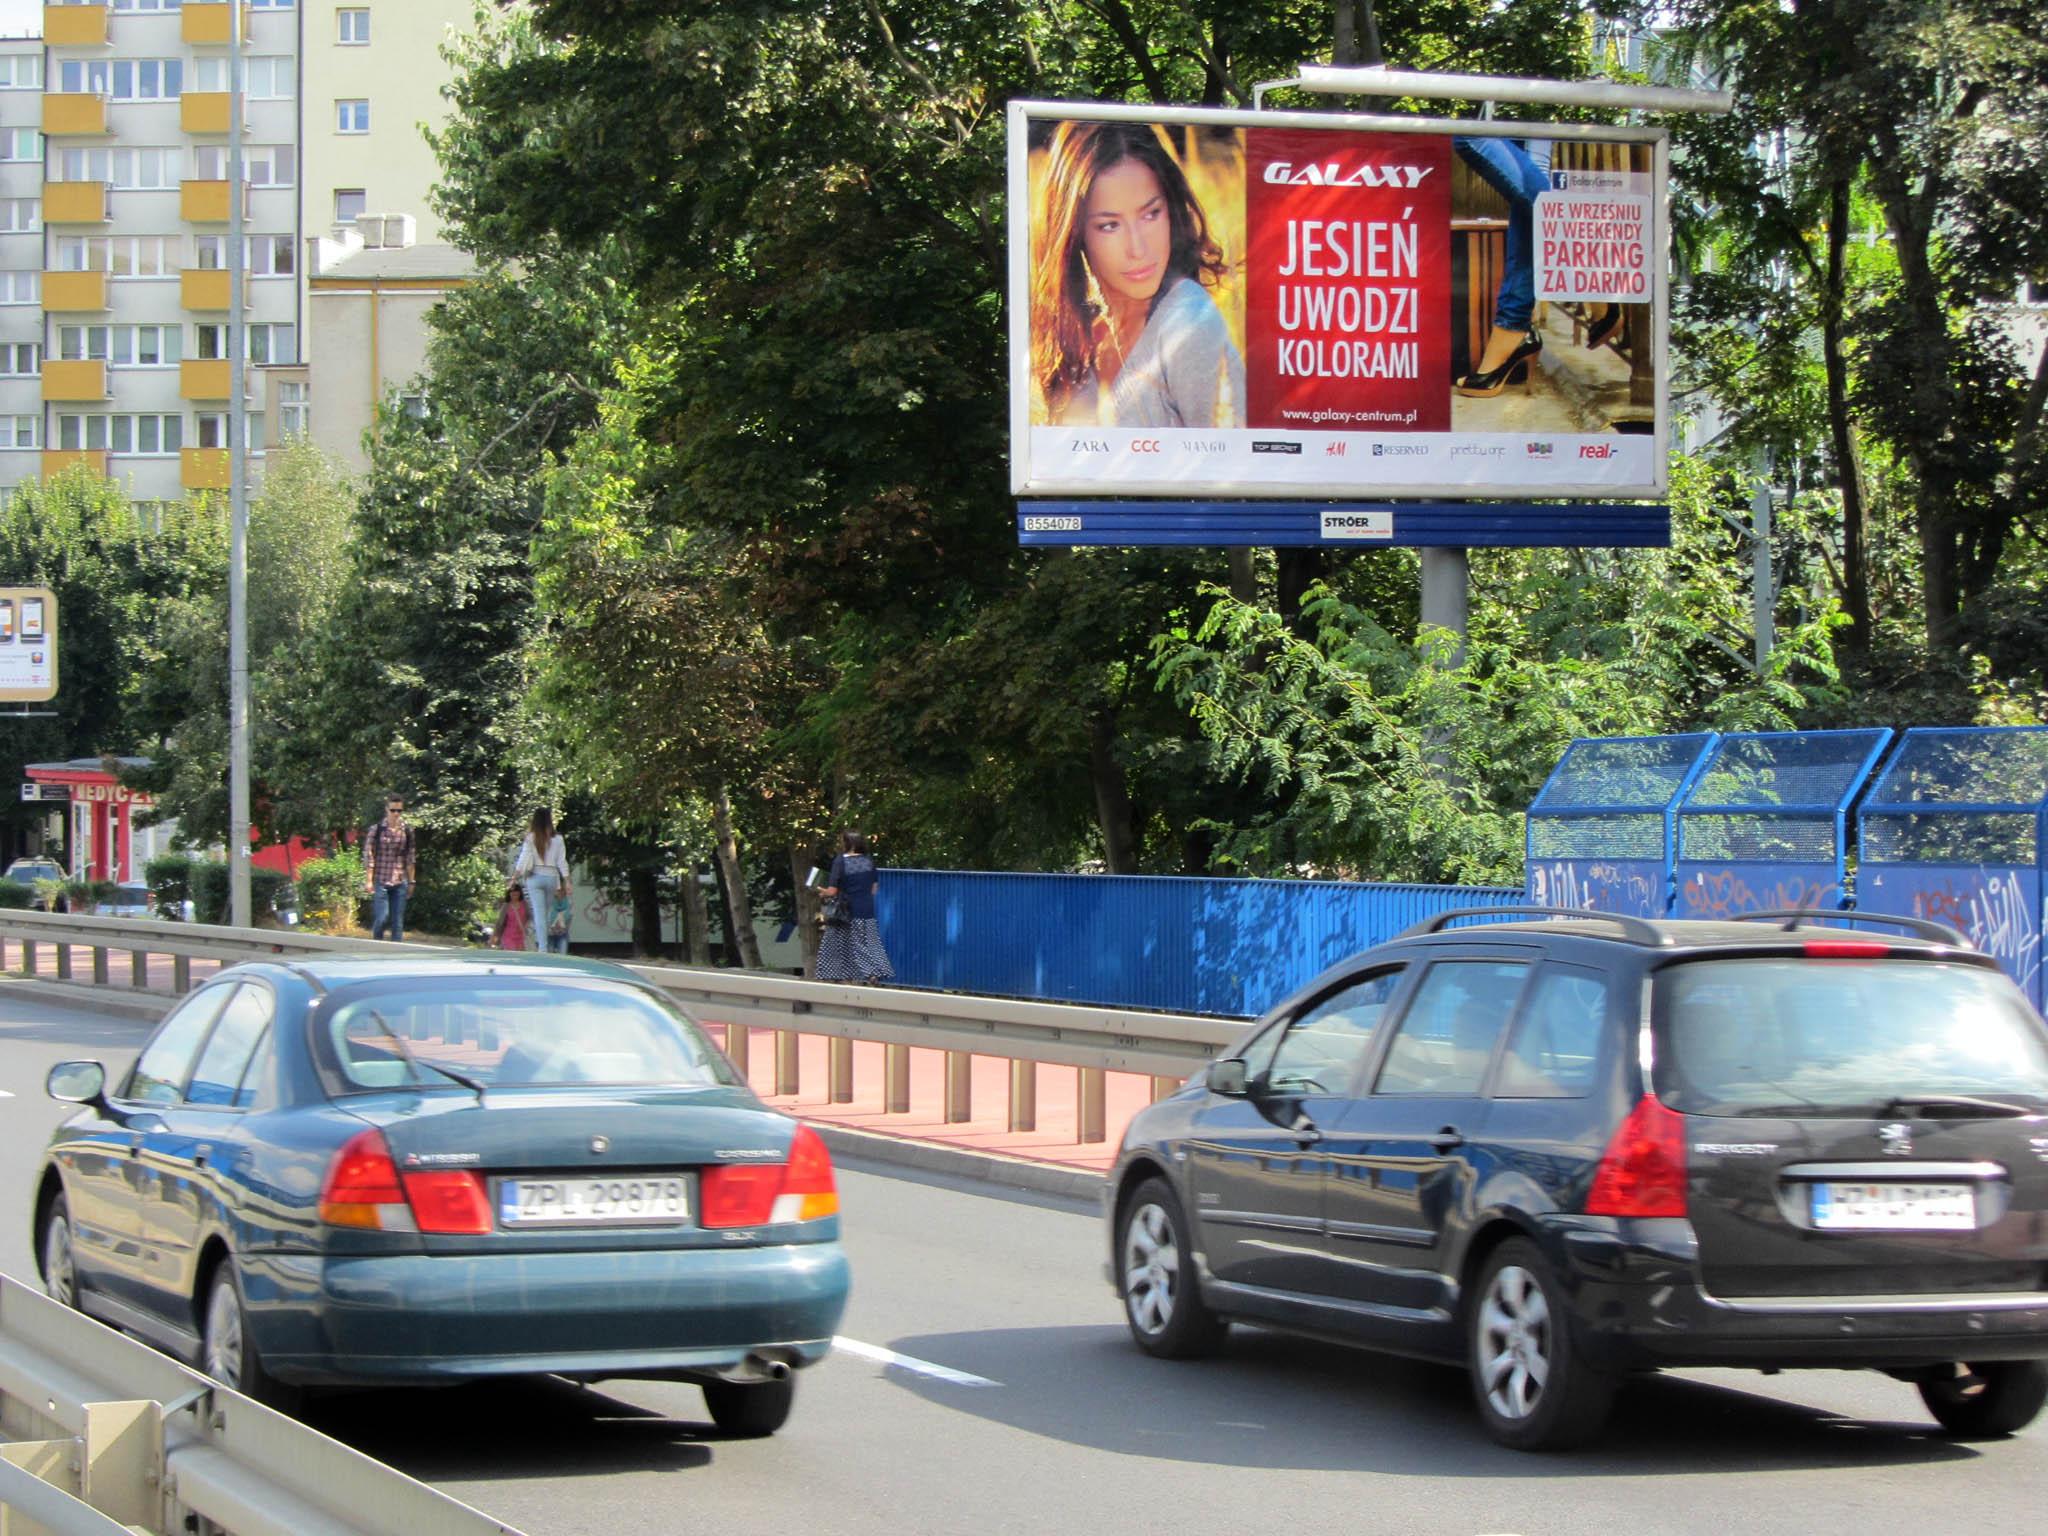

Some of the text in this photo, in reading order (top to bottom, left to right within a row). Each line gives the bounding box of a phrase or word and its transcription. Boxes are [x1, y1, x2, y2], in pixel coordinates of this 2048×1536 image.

[1263, 162, 1435, 188] GALAXY
[1541, 199, 1641, 221] WE WRZEŚNIU
[1541, 220, 1643, 241] W WEEKENDY
[1278, 206, 1418, 278] JESIEŃ
[1543, 240, 1645, 269] PARKING
[1542, 269, 1646, 295] ZA DARMO
[1278, 285, 1418, 334] UWODZI
[1277, 338, 1419, 379] KOLORAMI
[1281, 407, 1418, 425] www.galaxy-centrum.pl
[1071, 439, 1111, 453] ZARA
[1130, 439, 1161, 453] CCC
[1182, 440, 1227, 454] MANGO
[1026, 517, 1080, 531] 8554078
[1324, 515, 1369, 528] STRÖER
[521, 1181, 686, 1216] ZPL 29878
